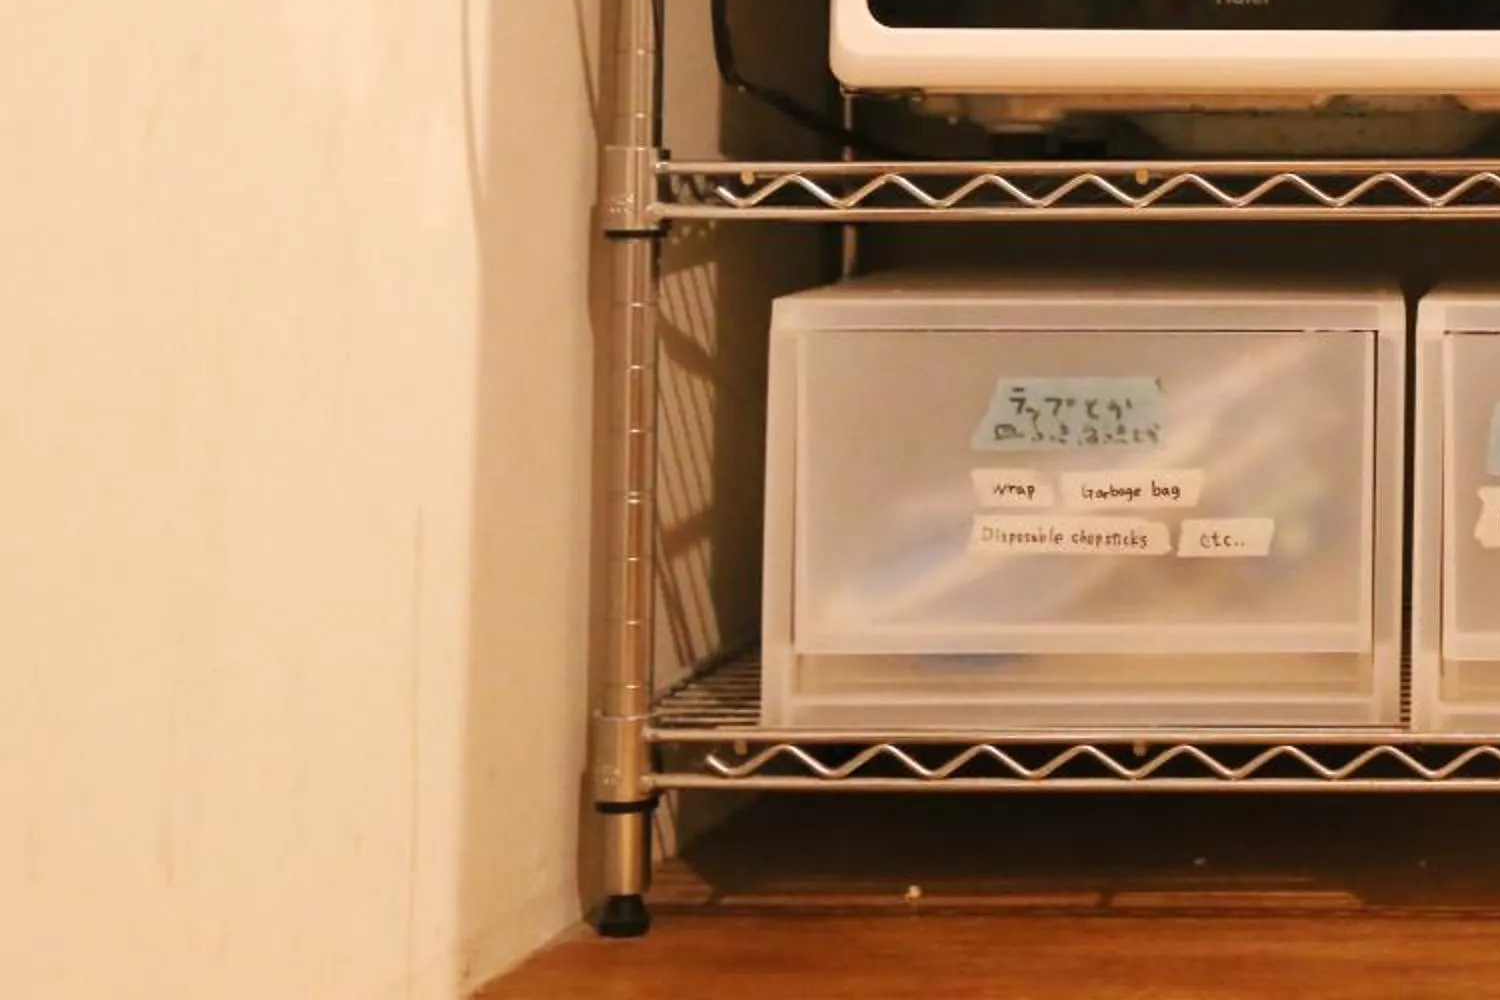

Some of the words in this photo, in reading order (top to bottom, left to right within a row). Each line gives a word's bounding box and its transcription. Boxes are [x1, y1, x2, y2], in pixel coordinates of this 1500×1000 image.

[992, 484, 1036, 497] wrap
[1081, 484, 1141, 501] Garbage
[1151, 480, 1180, 500] bag
[1071, 531, 1149, 547] chopsticks
